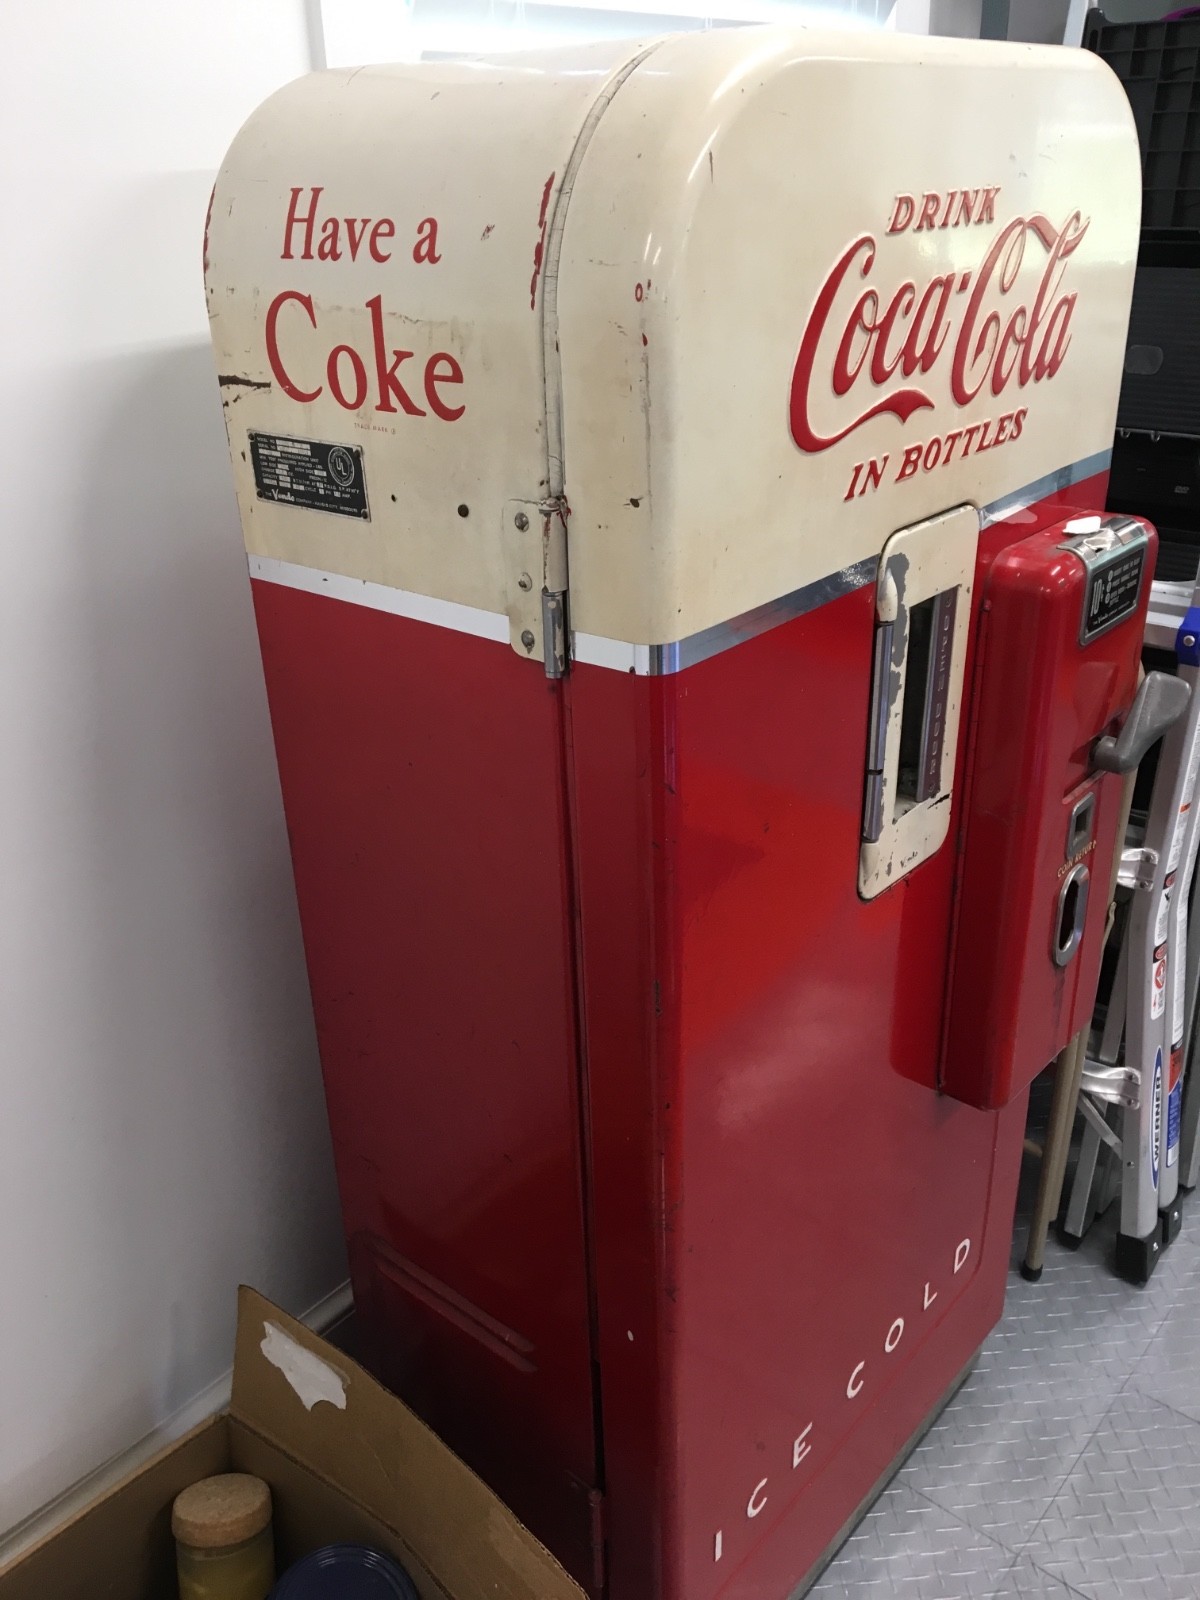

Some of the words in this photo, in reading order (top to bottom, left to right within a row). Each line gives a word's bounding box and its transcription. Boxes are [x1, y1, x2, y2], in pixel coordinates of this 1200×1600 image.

[280, 187, 395, 263] Have
[412, 216, 442, 265] a
[886, 185, 1001, 235] DRINK
[265, 290, 466, 422] Coke
[789, 207, 1091, 453] Coca-Cola
[843, 454, 889, 502] IN
[895, 406, 1028, 482] BOTTLES
[1057, 856, 1073, 878] COIN
[714, 1421, 813, 1563] ICE
[846, 1238, 971, 1399] COLD
